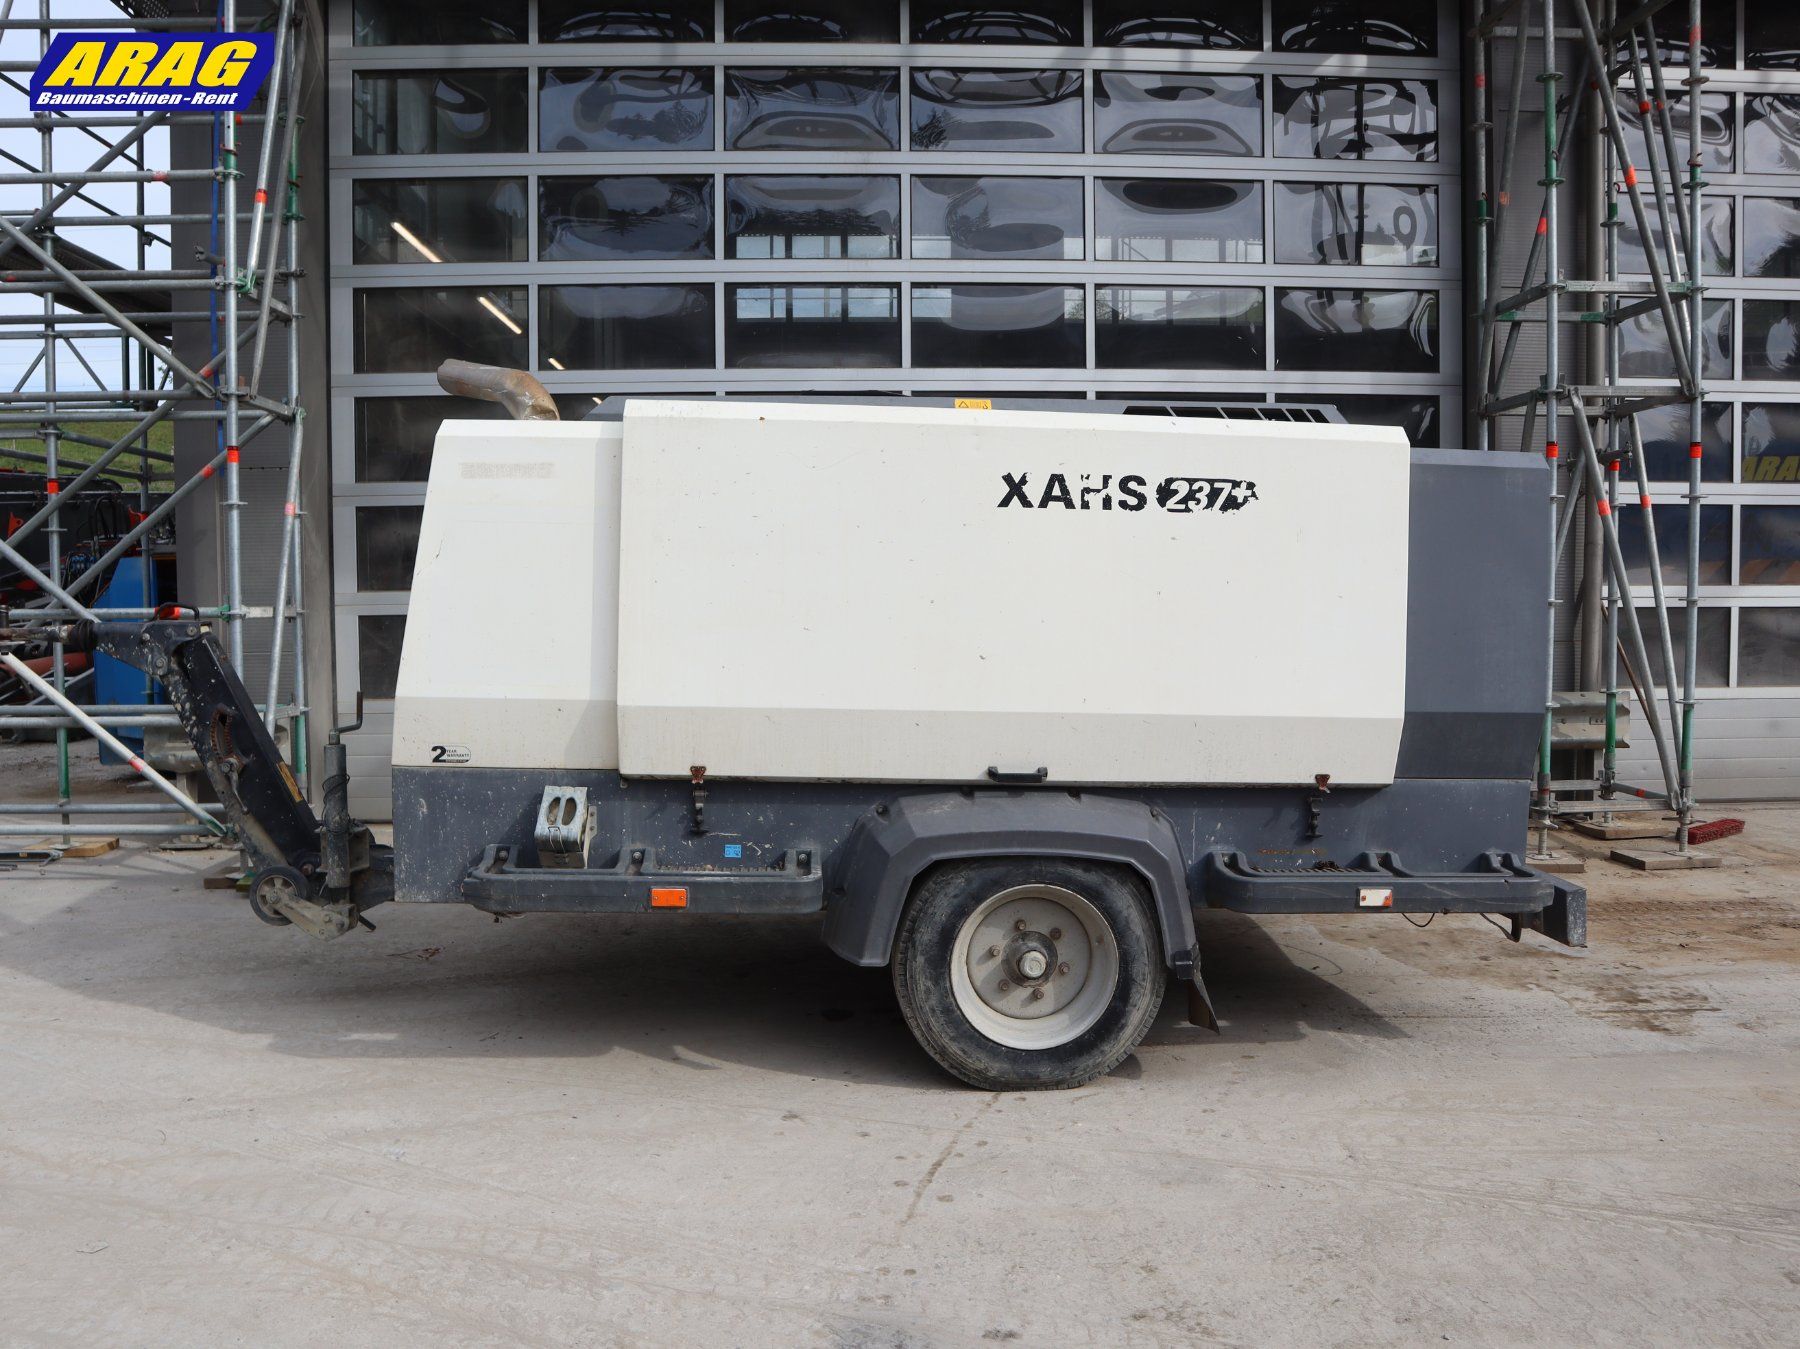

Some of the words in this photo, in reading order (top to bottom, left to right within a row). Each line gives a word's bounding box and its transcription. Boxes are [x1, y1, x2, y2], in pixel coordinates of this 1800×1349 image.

[1742, 455, 1800, 481] ARA
[997, 472, 1148, 511] XAHS
[431, 745, 447, 763] 2
